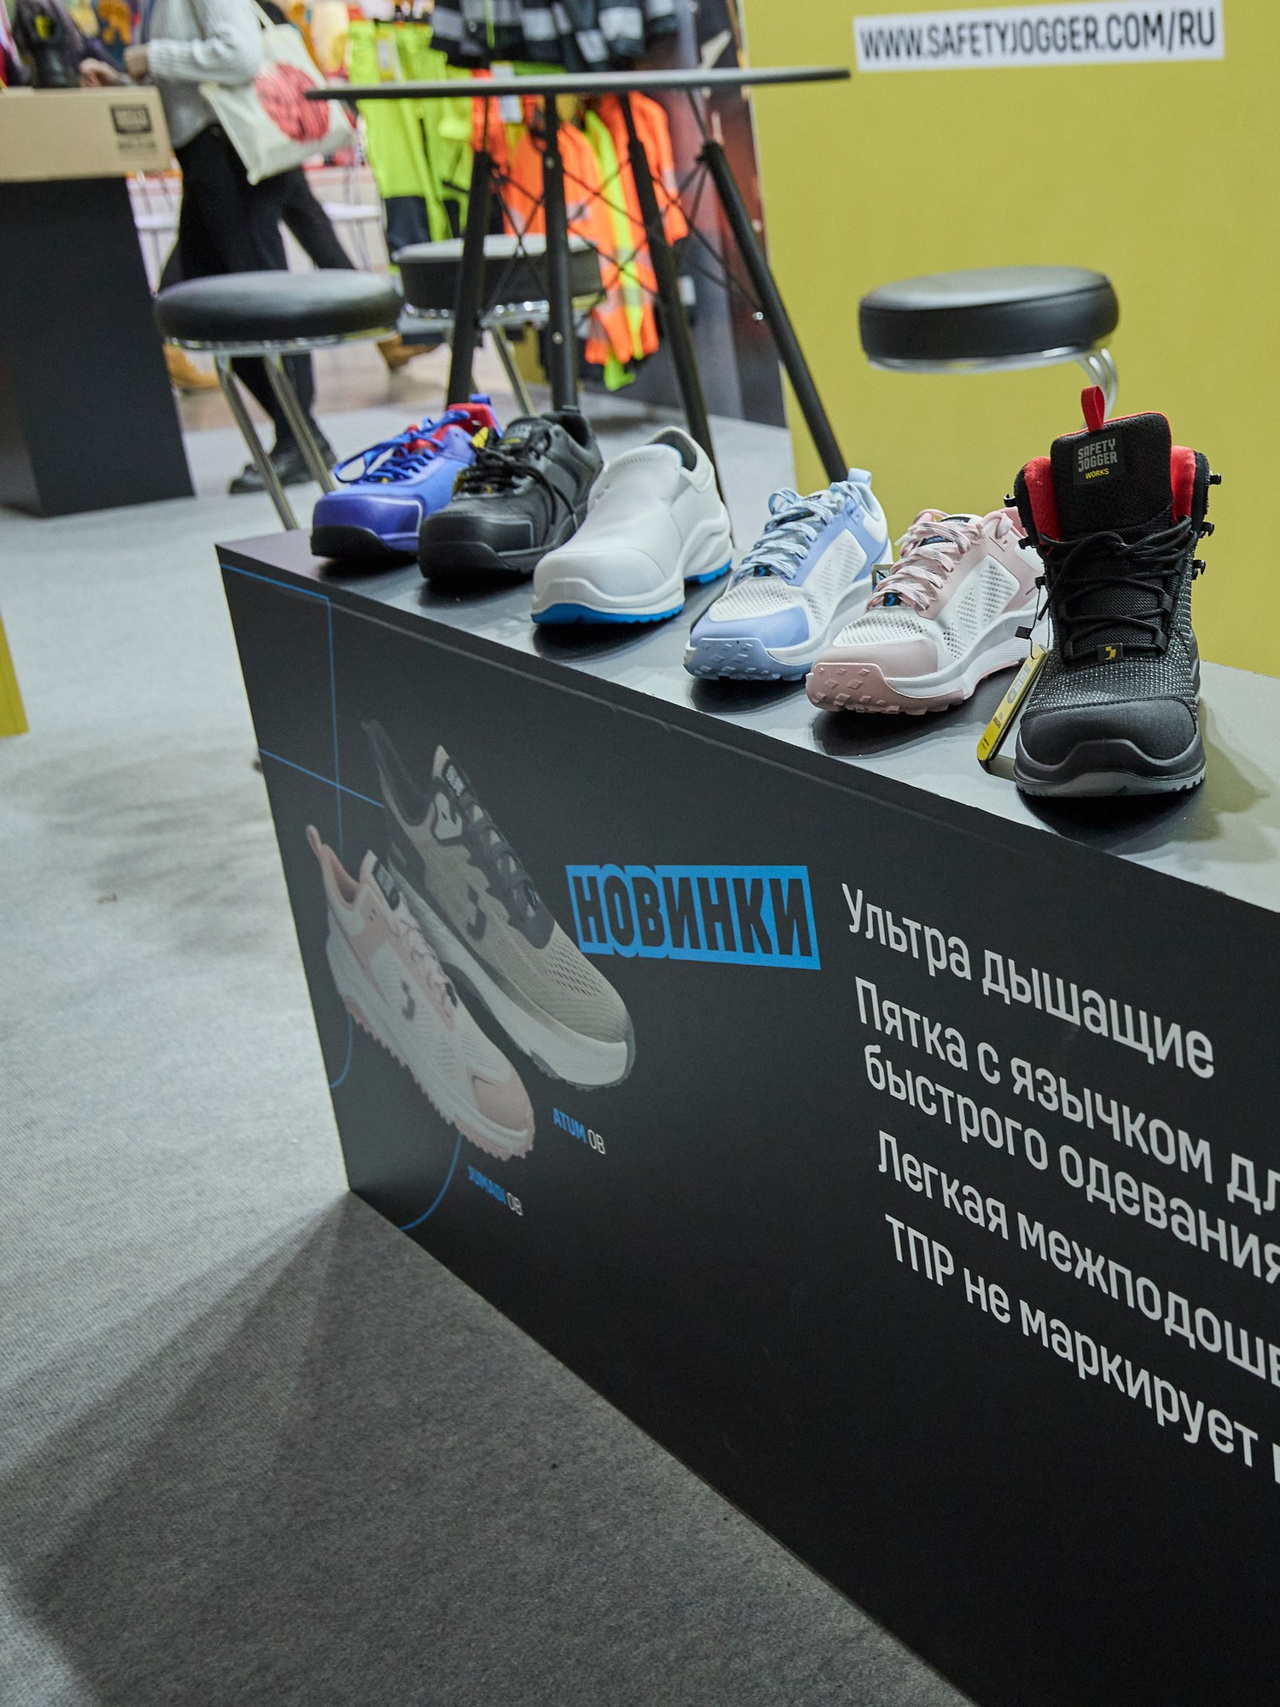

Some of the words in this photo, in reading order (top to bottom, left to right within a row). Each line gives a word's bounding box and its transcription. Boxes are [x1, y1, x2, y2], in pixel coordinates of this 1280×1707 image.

[859, 9, 1215, 59] WWW.SAFETYJOGGER.COM/RU
[1078, 438, 1116, 460] SAFETY
[1078, 451, 1118, 472] JOGGER
[1085, 468, 1110, 479] WORKS
[571, 874, 814, 958] НОВИНКИ
[841, 883, 972, 981] Ультра
[982, 949, 1215, 1079] дышащие
[855, 976, 968, 1071] Пятка
[977, 1042, 1001, 1085] с
[1010, 1057, 1213, 1184] язычком
[864, 1043, 1048, 1171] быстрого
[552, 1107, 587, 1144] ATUM
[878, 1130, 1010, 1241] Легкая
[885, 1213, 955, 1287] ТПР
[963, 1267, 1011, 1324] не
[1020, 1298, 1258, 1468] маркирует
